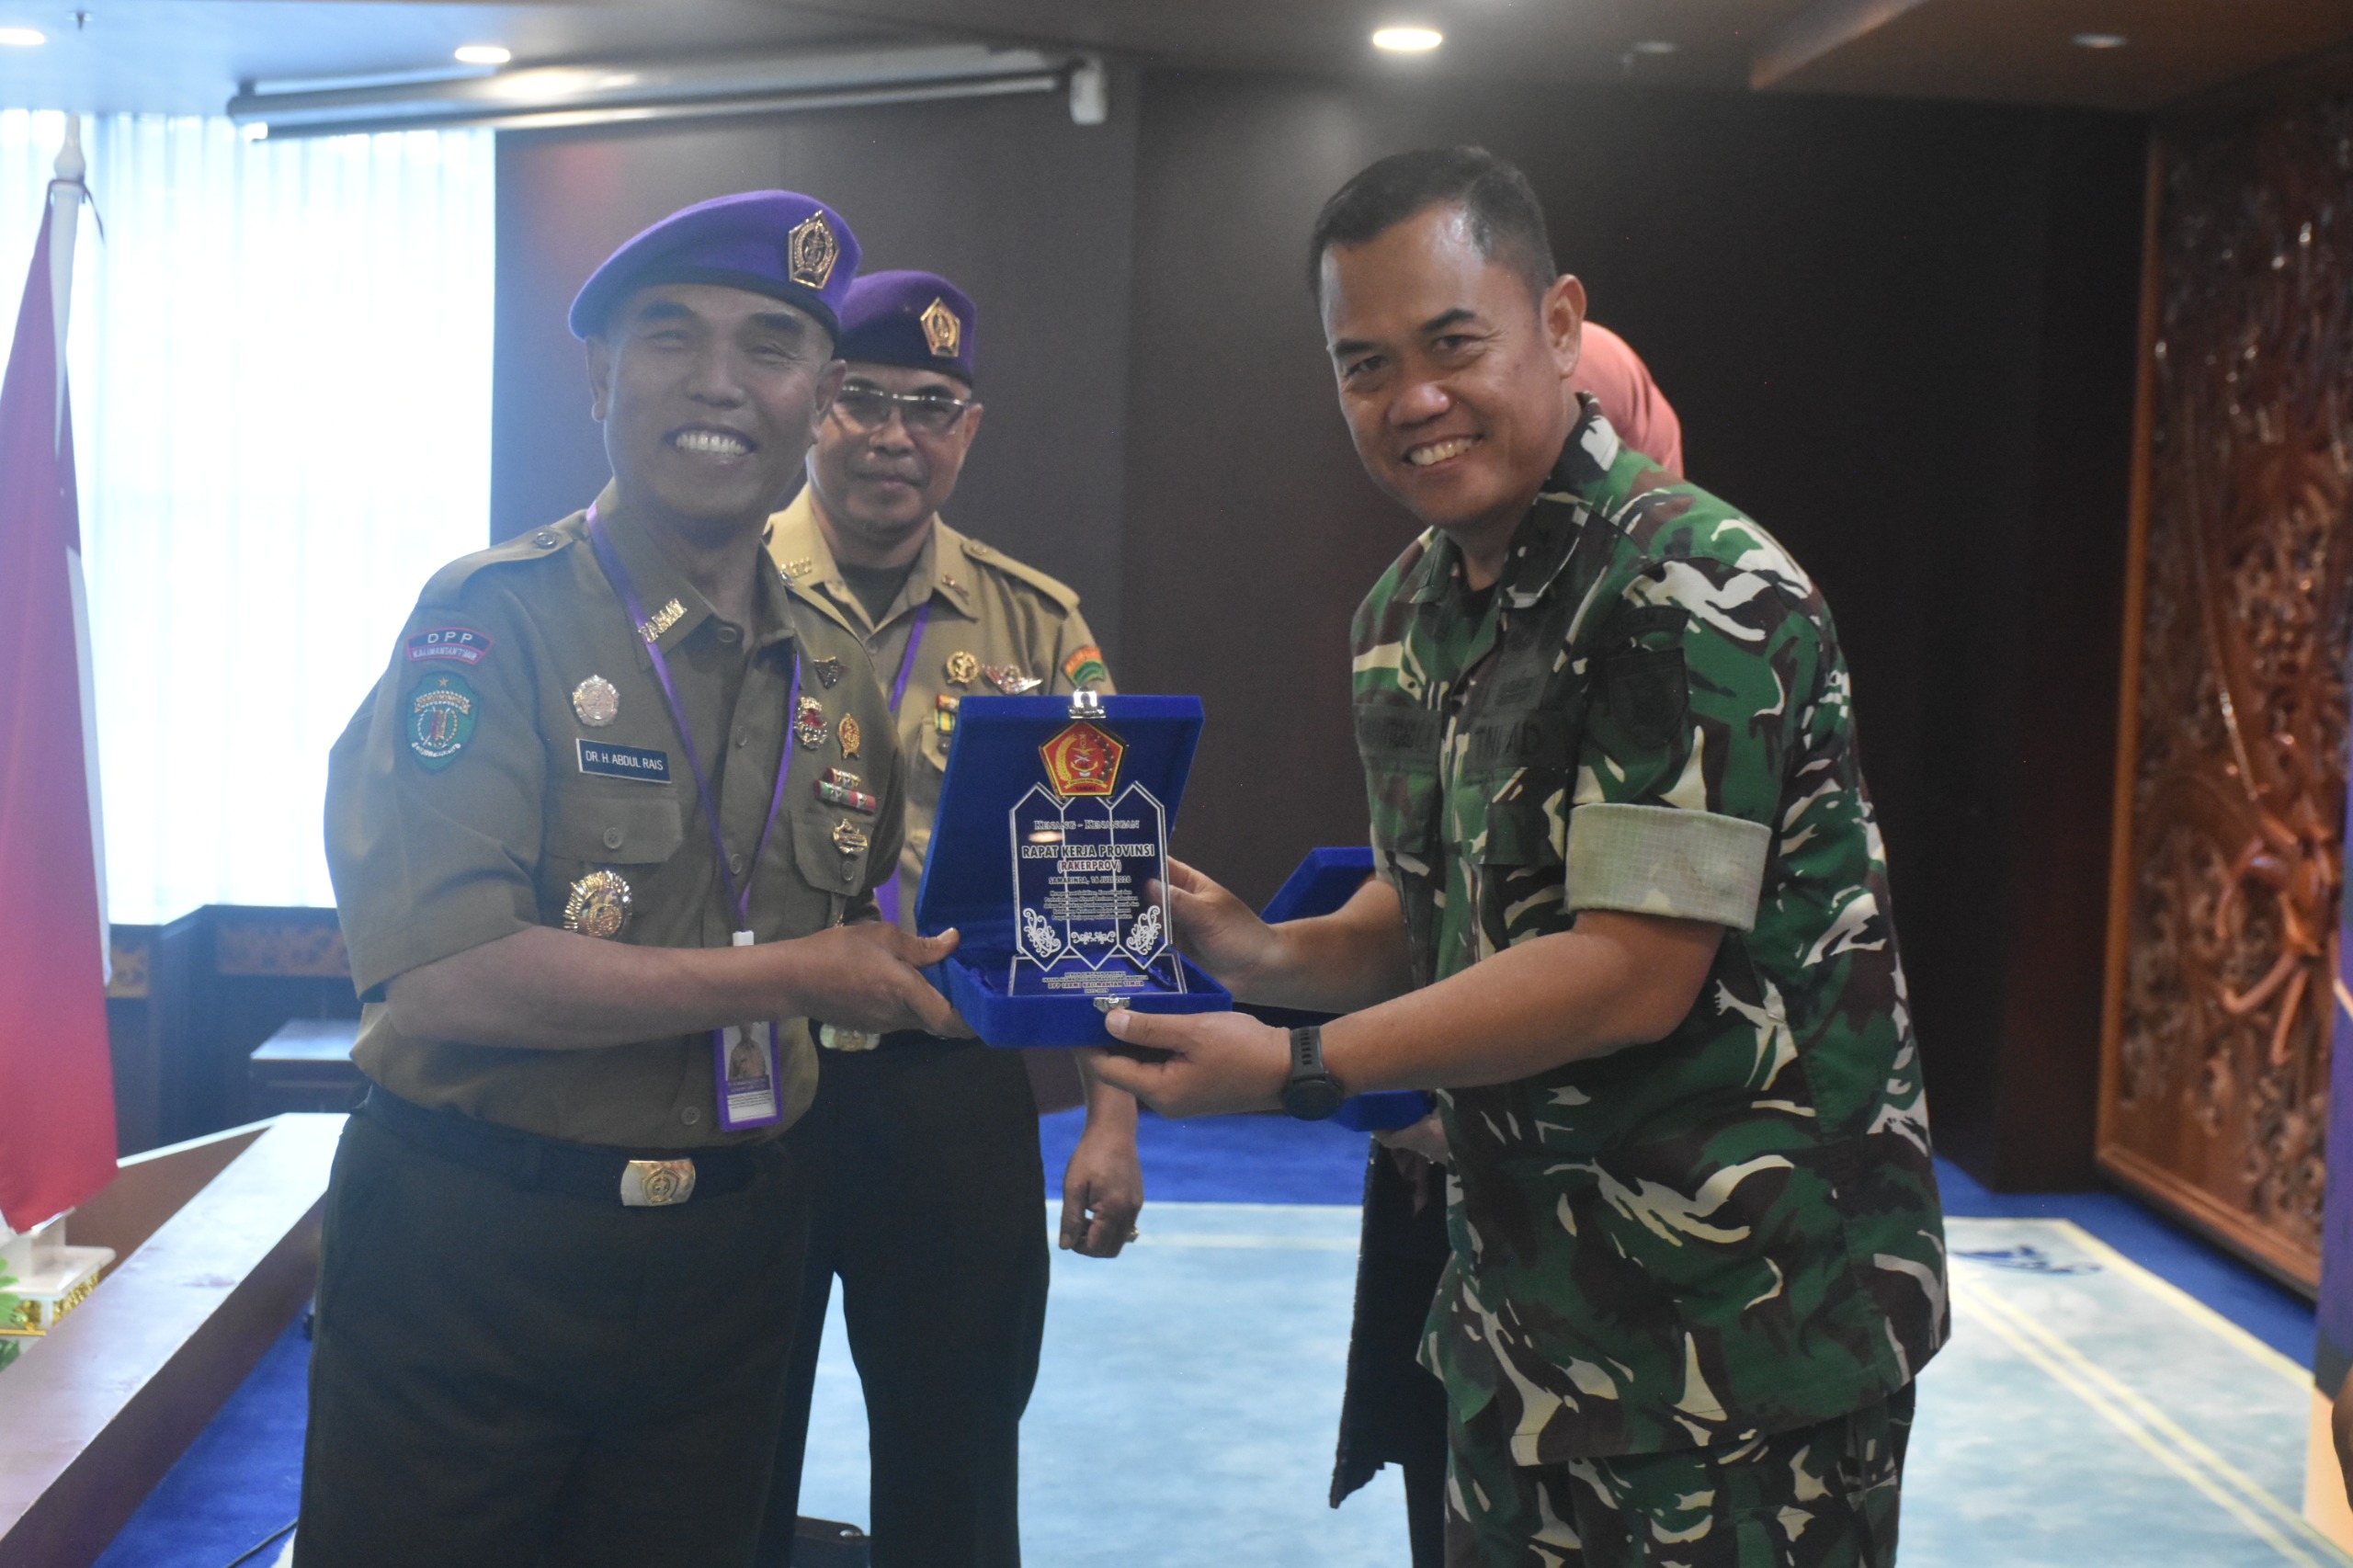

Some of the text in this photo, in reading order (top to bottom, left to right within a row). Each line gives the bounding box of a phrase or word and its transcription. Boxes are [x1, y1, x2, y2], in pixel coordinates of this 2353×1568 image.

[427, 631, 472, 643] DPP
[585, 750, 600, 763] DR.
[612, 754, 642, 768] ABDUL
[642, 757, 664, 771] RAIS
[1021, 844, 1155, 858] RAPAT KERJA PROVINSI
[1057, 859, 1122, 873] (RAKERPROV)
[1048, 876, 1089, 885] SAMARINDA,
